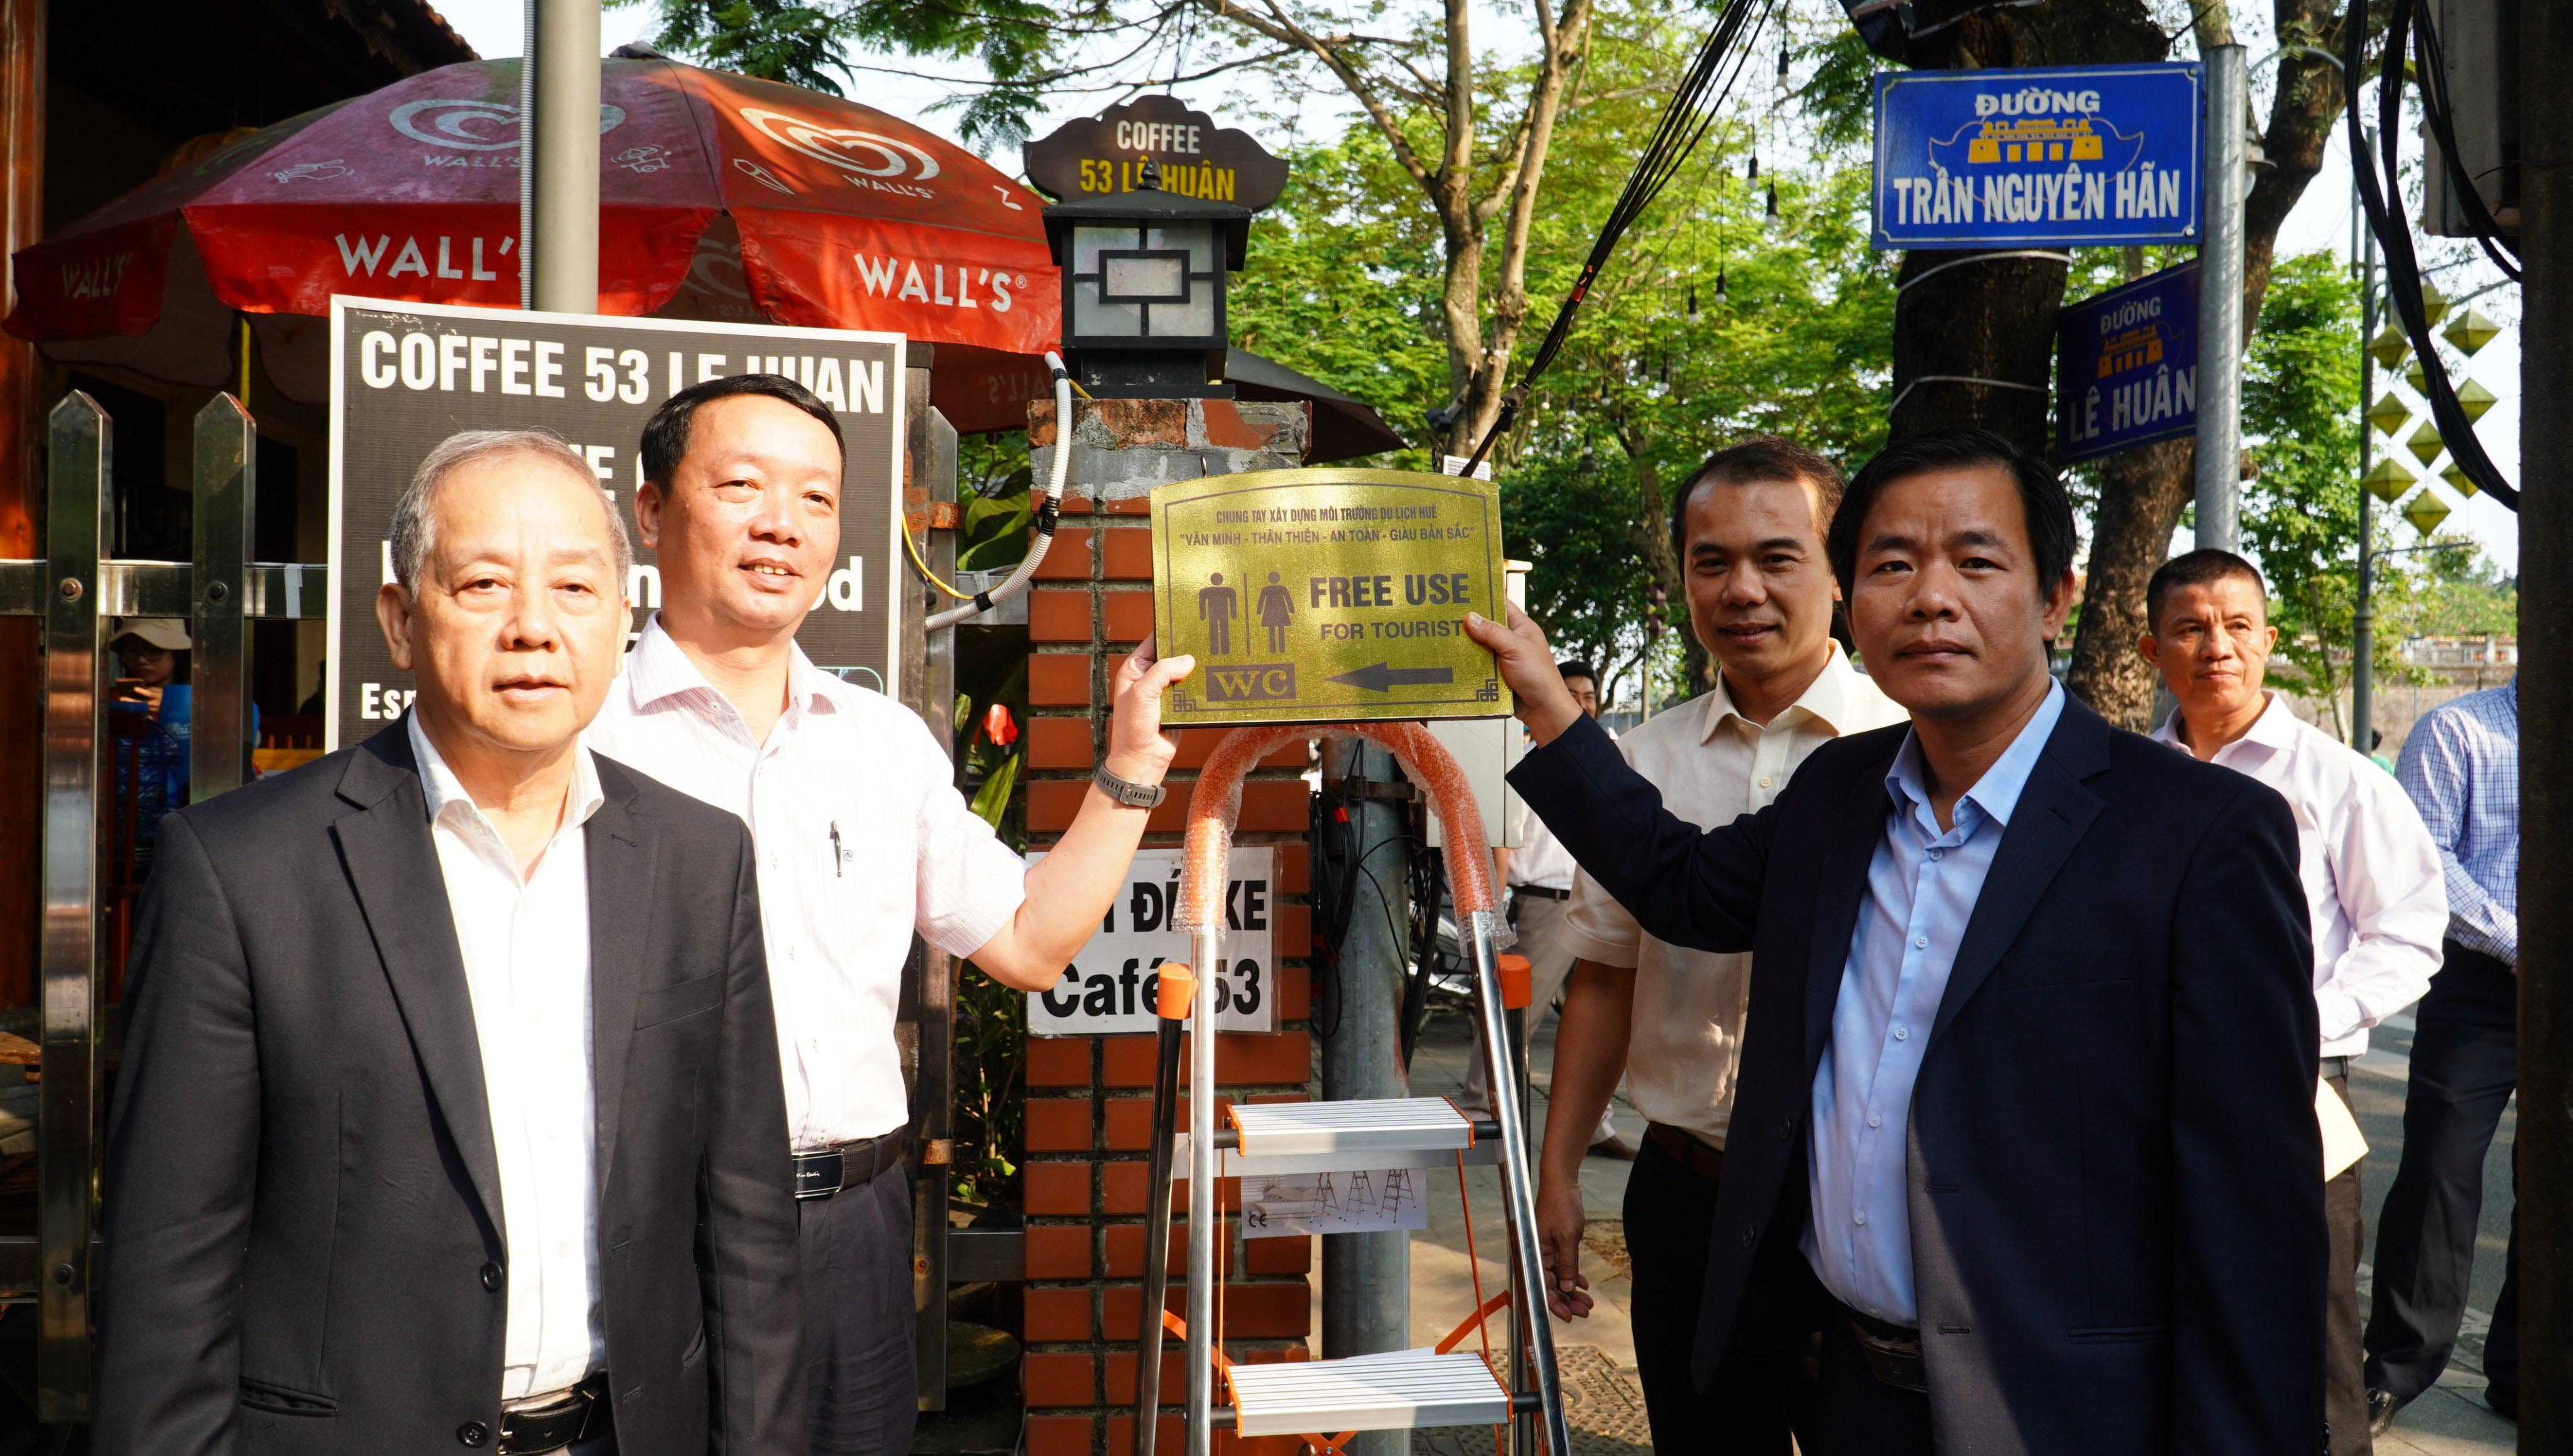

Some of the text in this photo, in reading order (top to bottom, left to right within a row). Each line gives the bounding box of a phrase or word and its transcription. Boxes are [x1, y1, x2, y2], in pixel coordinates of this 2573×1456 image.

[1974, 87, 2100, 116] ĐƯỜNG
[1117, 120, 1201, 154] COFFEE
[1079, 158, 1113, 193] 53
[1162, 159, 1235, 201] HUÂN
[1984, 162, 2105, 223] NGUYÊN
[2116, 160, 2180, 219] HÃN
[2100, 296, 2161, 335] ĐƯỜNG
[361, 330, 565, 398] COFFEE
[584, 346, 649, 404] 53
[2070, 363, 2197, 443] LÊ HUÂN
[1216, 503, 1437, 525] CHUNG TAY XÂY DỰNG MÔI TRƯỜNG DU LỊCH HUẾ
[1213, 533, 1241, 545] MINH
[1251, 529, 1282, 544] THÂN
[1285, 528, 1319, 545] THIỆN
[1330, 530, 1345, 542] AN
[1348, 526, 1380, 541] TOÀN
[1389, 526, 1416, 541] GIÀU
[1421, 523, 1443, 540] BẢN
[1310, 573, 1470, 608] FREE USE
[1321, 622, 1364, 639] FOR
[1213, 669, 1287, 698] WC
